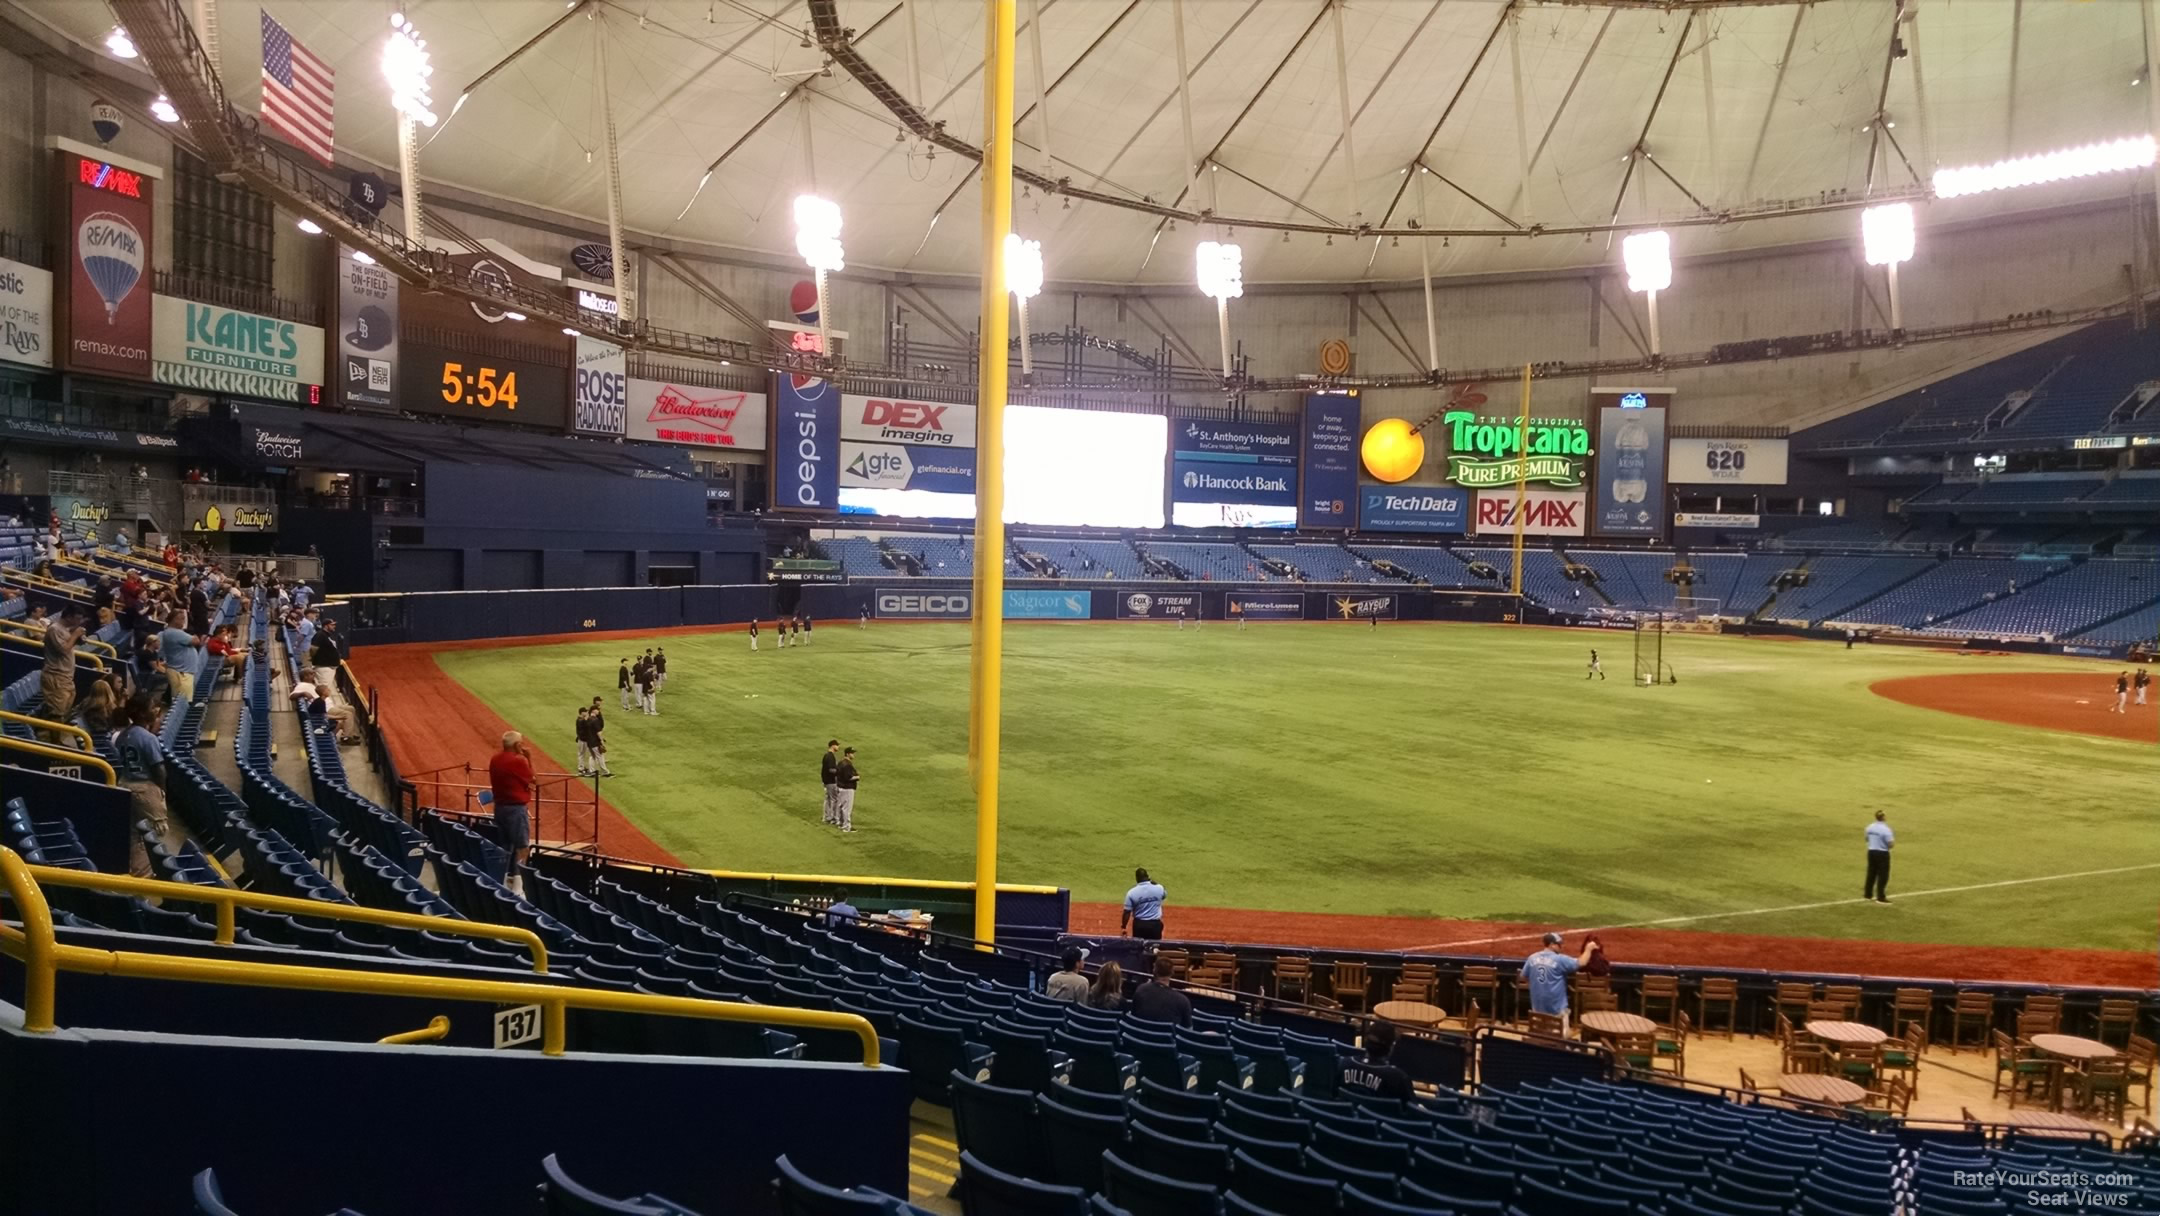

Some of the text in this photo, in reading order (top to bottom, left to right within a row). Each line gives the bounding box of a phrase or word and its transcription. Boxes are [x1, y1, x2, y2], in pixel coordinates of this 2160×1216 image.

[80, 160, 140, 198] RE/MAX
[362, 182, 375, 204] TB
[86, 226, 137, 256] RE/MAX
[350, 272, 389, 291] ON-FIELD
[351, 263, 388, 280] THE OFFICIAL
[8, 306, 20, 320] OF
[23, 309, 39, 325] THE
[186, 303, 298, 360] KANE'S
[74, 339, 147, 360] remax.com
[191, 349, 292, 376] FURNITURE
[371, 365, 389, 377] NEW
[371, 374, 389, 386] ERA
[442, 362, 518, 410] 5:54
[577, 368, 625, 405] ROSE
[577, 402, 625, 432] RADIOLOGY
[656, 395, 736, 419] Budweiser
[861, 400, 948, 431] DEX
[1323, 415, 1342, 424] home
[1480, 416, 1584, 426] THE ORIGINAL
[256, 431, 301, 445] Budweiser
[881, 427, 954, 445] imaging
[1200, 430, 1290, 447] St. Anthony's Hospital
[1312, 432, 1351, 443] keeping you
[1444, 411, 1589, 458] Tropicana
[256, 442, 302, 459] PORCH
[795, 408, 821, 506] pepsi
[1313, 443, 1349, 452] connected.
[868, 452, 903, 475] gte
[1706, 450, 1745, 470] 620
[917, 464, 972, 477] gtefinancial.org
[1459, 461, 1571, 481] PURE PREMIUM
[1200, 474, 1288, 492] Hancock Bank
[71, 501, 110, 525] Ducky's
[234, 506, 273, 531] Ducky's
[1478, 498, 1578, 528] RE/MAX
[878, 595, 969, 613] GEICO
[1009, 591, 1060, 611] Sagicor
[1133, 597, 1147, 605] FOX
[1157, 597, 1192, 606] STREAM
[583, 619, 597, 628] 404
[1536, 965, 1547, 985] 3
[498, 1008, 537, 1044] 137
[1344, 1068, 1383, 1092] DILLON
